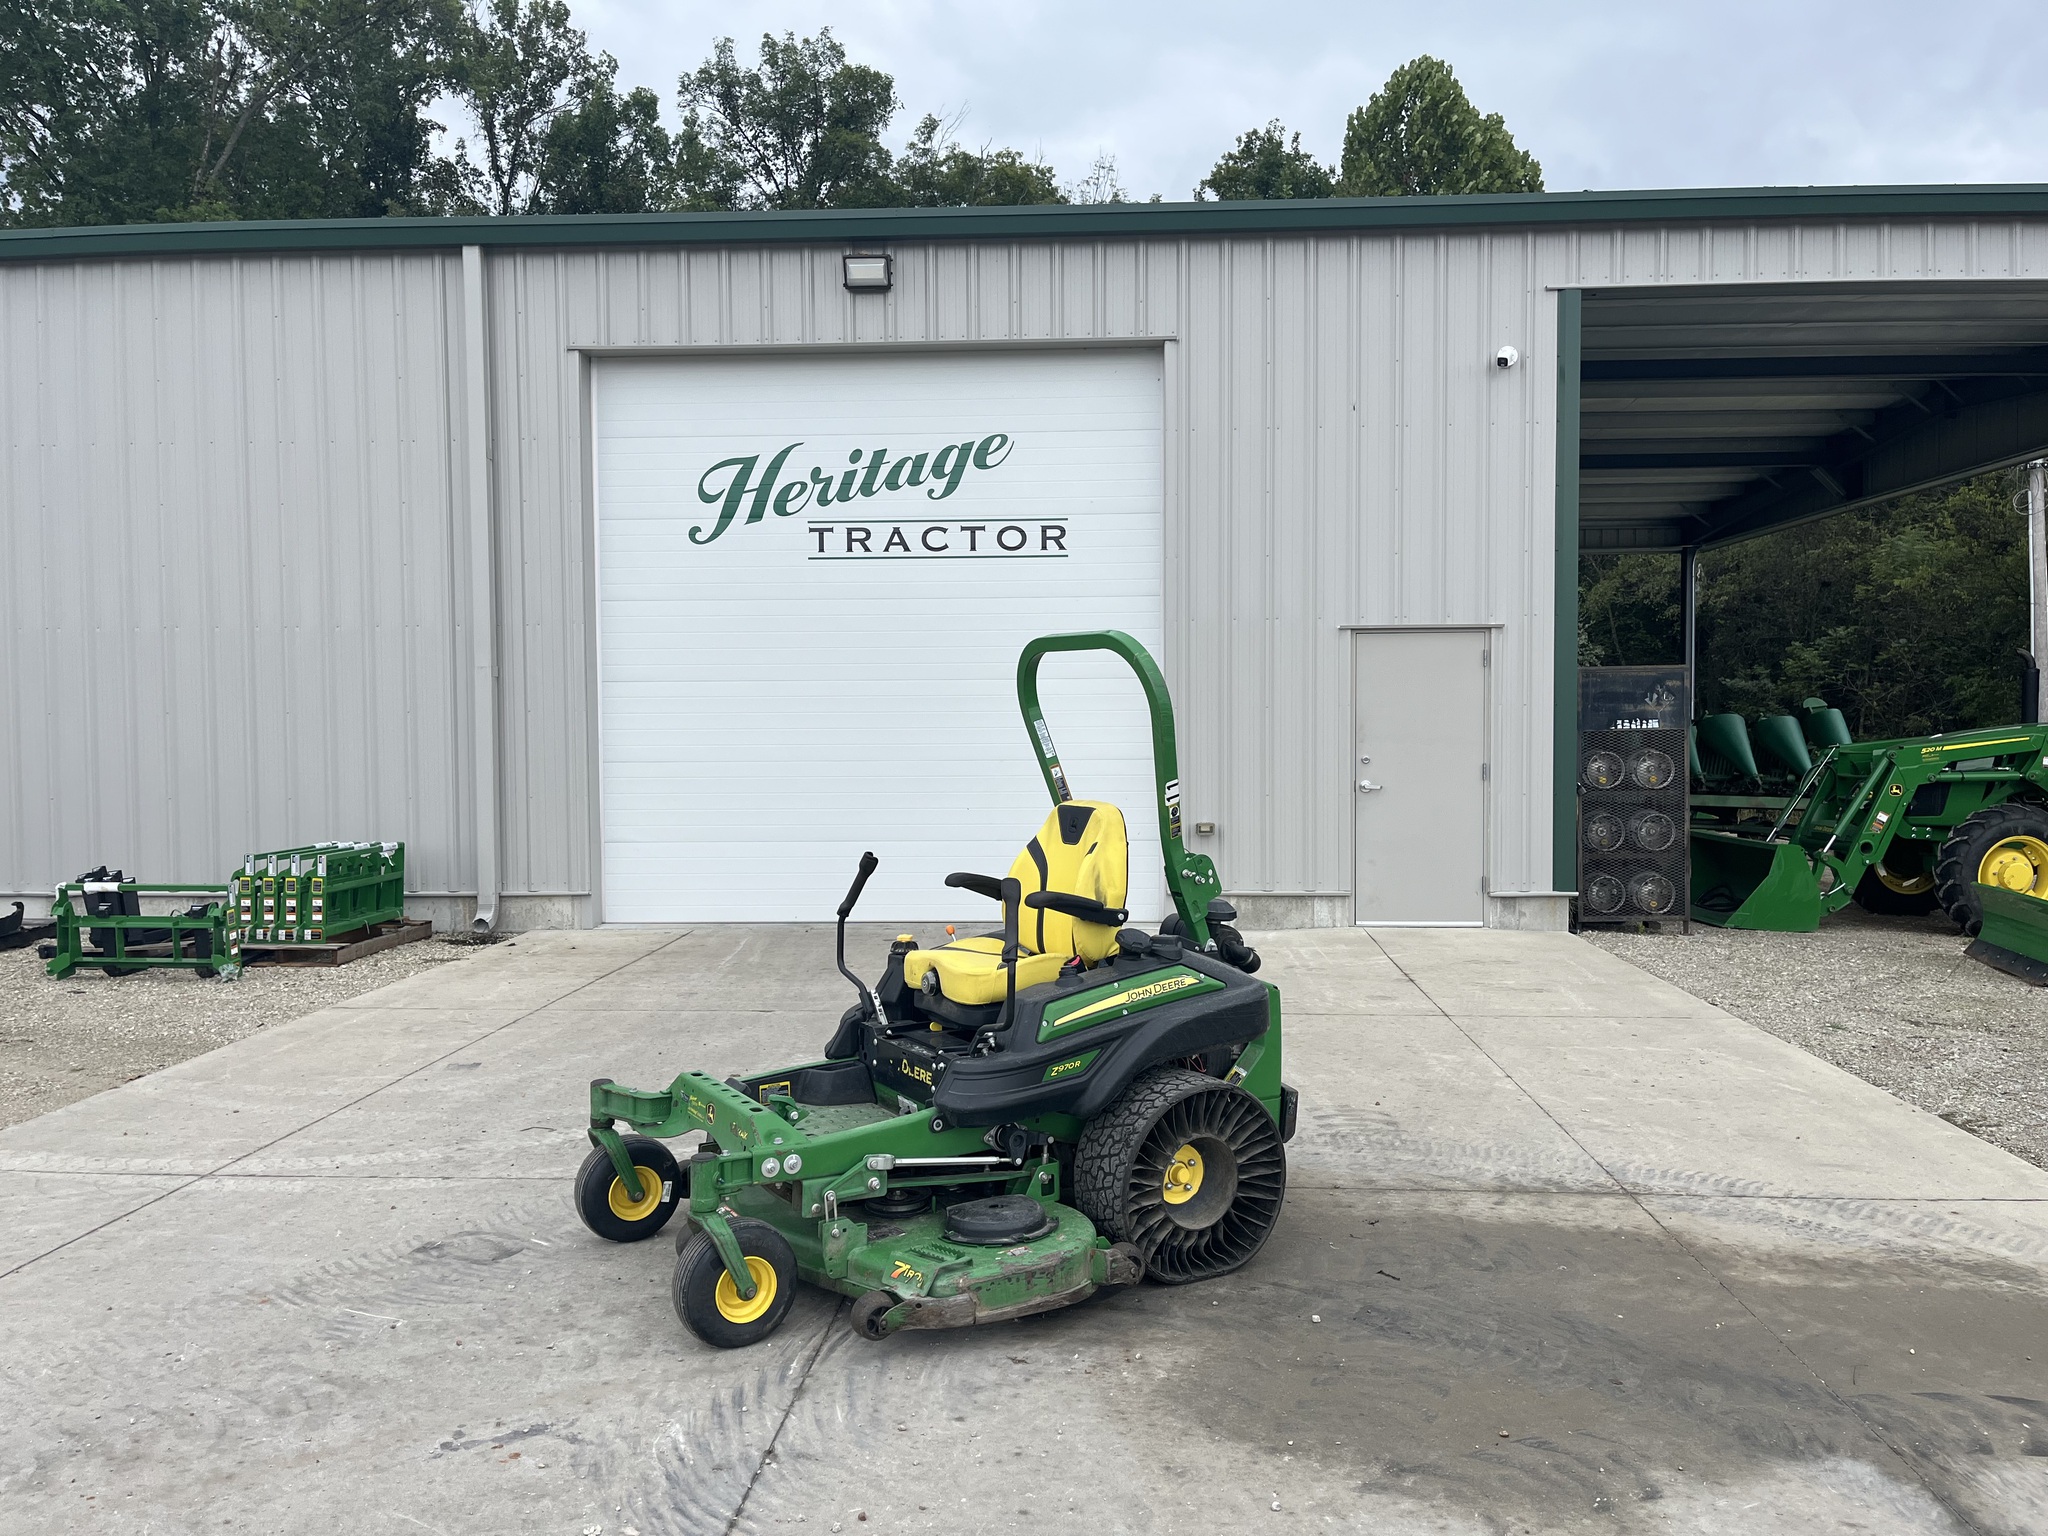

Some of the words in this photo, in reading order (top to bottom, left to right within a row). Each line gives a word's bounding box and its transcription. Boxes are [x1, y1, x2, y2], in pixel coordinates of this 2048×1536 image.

[688, 433, 1015, 545] Heritage
[808, 525, 1068, 553] TRACTOR
[1125, 988, 1152, 1002] JOHN
[1153, 978, 1187, 994] DEERE
